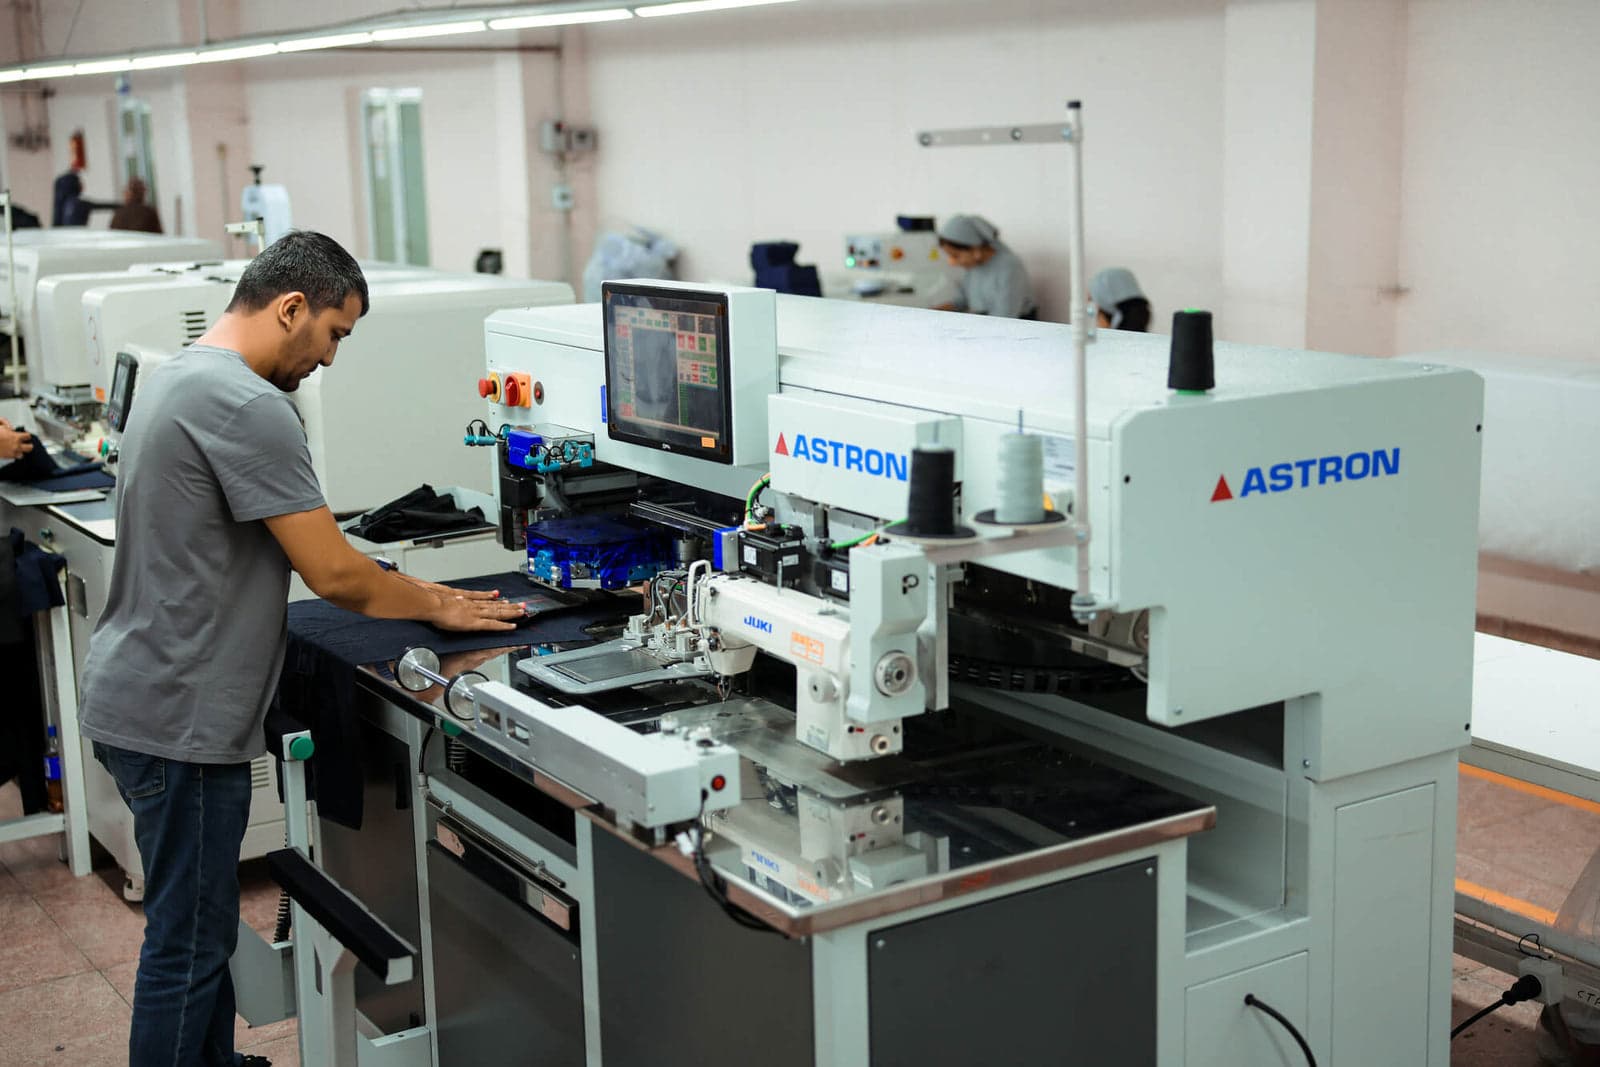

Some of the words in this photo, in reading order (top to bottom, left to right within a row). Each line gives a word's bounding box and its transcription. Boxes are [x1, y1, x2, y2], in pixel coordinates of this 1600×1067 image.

[792, 433, 908, 482] ASTRON
[1240, 447, 1400, 498] ASTRON
[743, 613, 773, 634] JUKI
